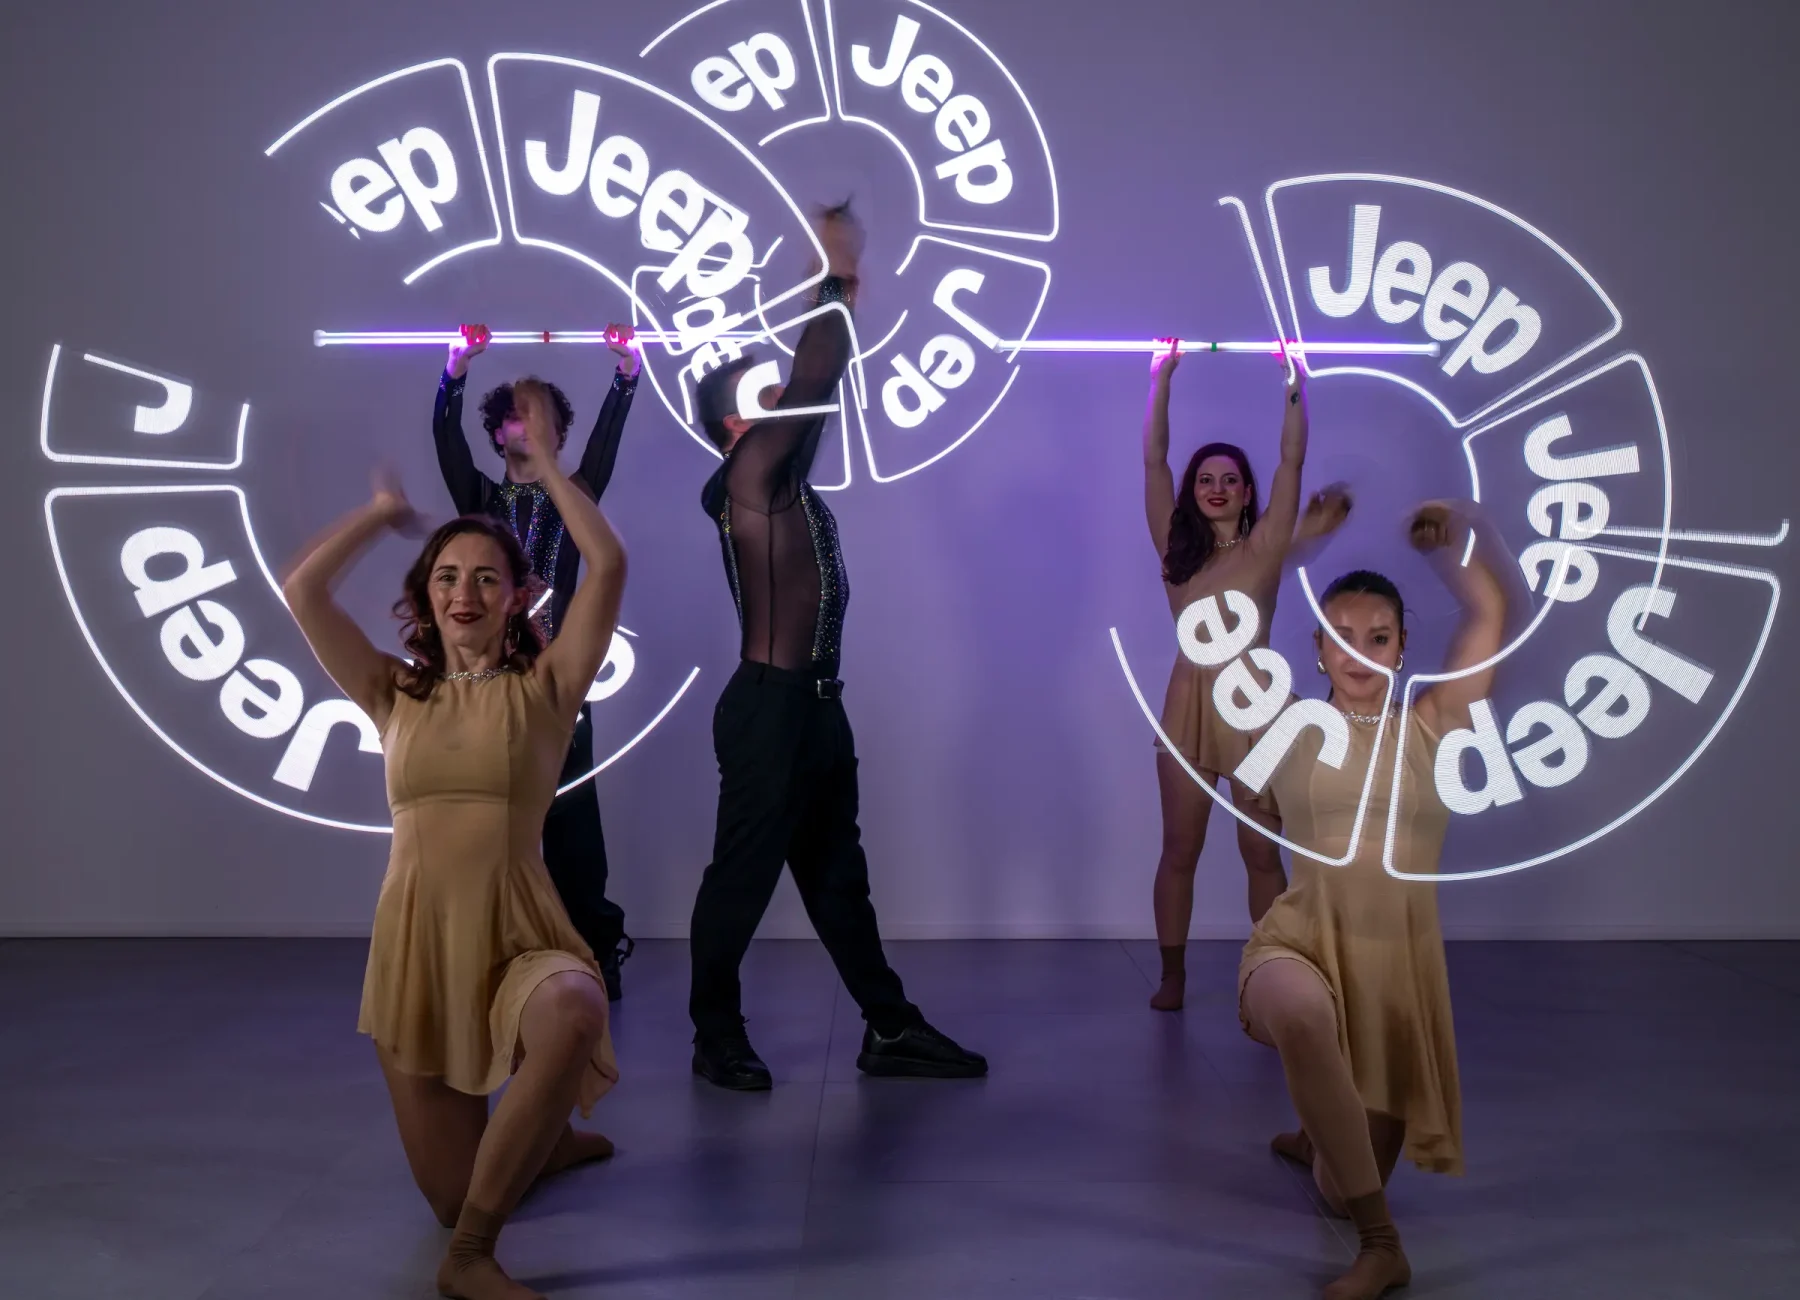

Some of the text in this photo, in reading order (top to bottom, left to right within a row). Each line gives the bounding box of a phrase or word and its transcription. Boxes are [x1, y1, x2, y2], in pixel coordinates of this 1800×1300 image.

[524, 89, 754, 298] Jeep
[851, 14, 1013, 205] Jeep
[1308, 204, 1542, 377] Jeep
[120, 526, 382, 792] Jeep
[1433, 582, 1716, 816] Jeep
